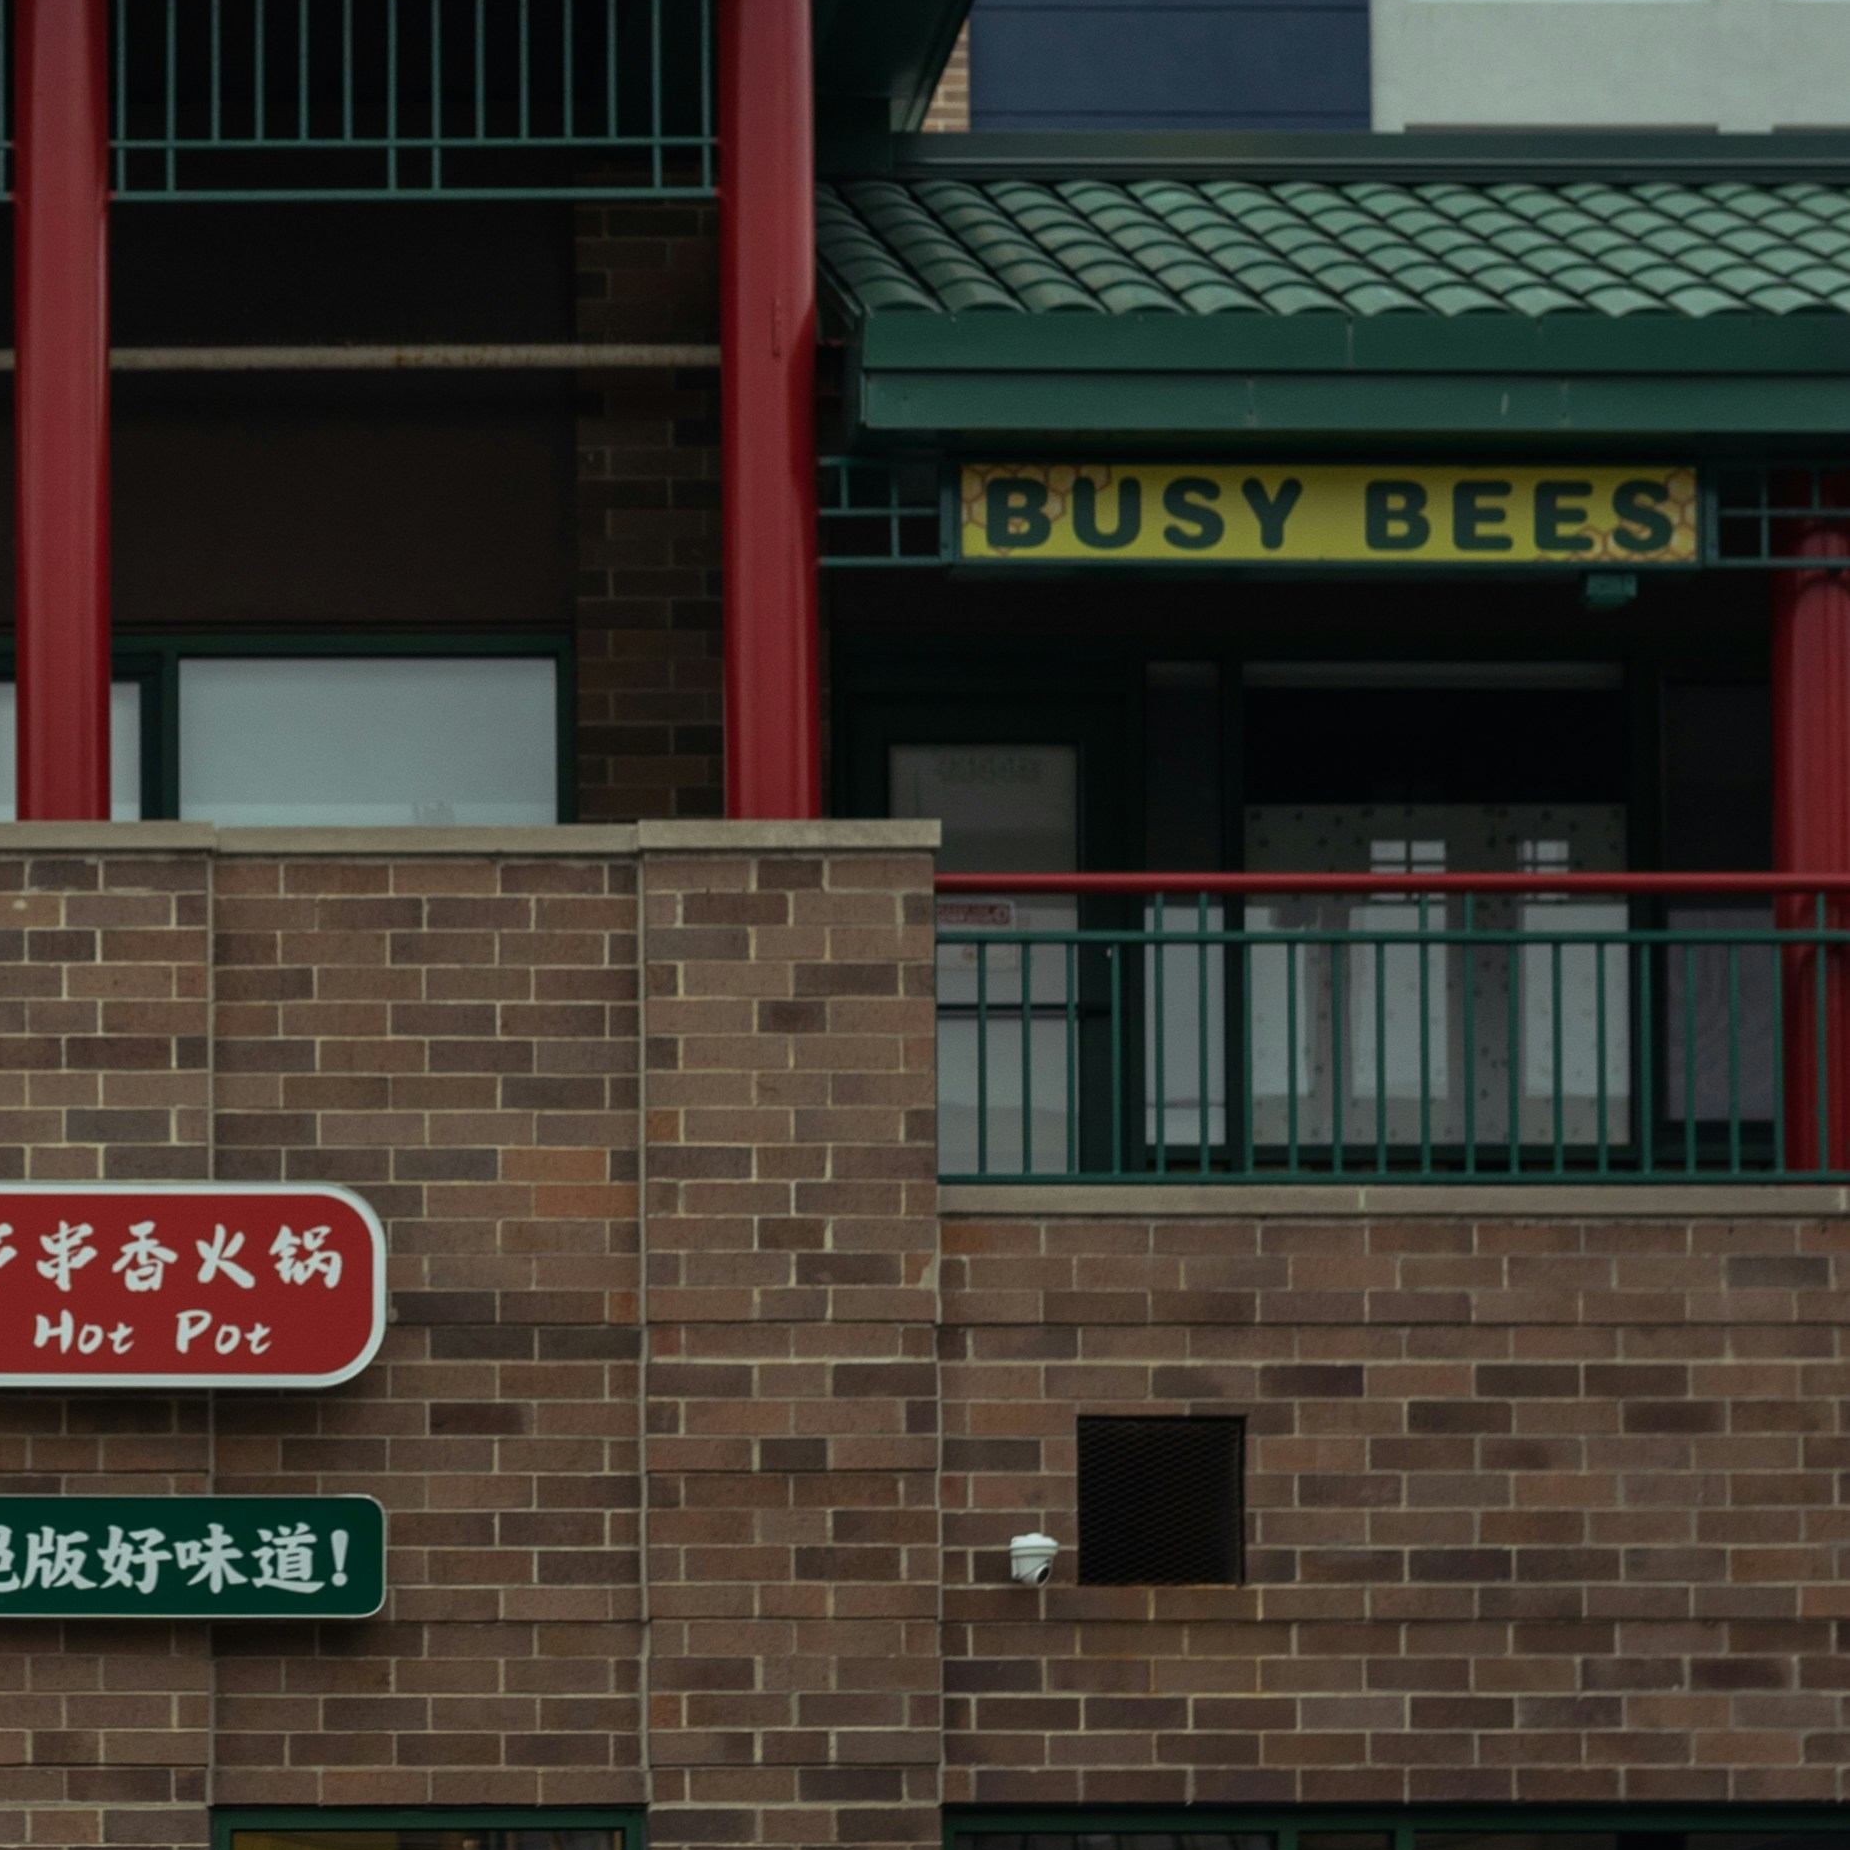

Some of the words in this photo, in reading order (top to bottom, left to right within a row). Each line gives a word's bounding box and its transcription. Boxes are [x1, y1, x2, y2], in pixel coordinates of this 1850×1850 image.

[984, 475, 1303, 550] BUSY
[1365, 479, 1675, 553] BEES
[32, 1309, 135, 1354] Hot
[174, 1309, 272, 1355] Pot
